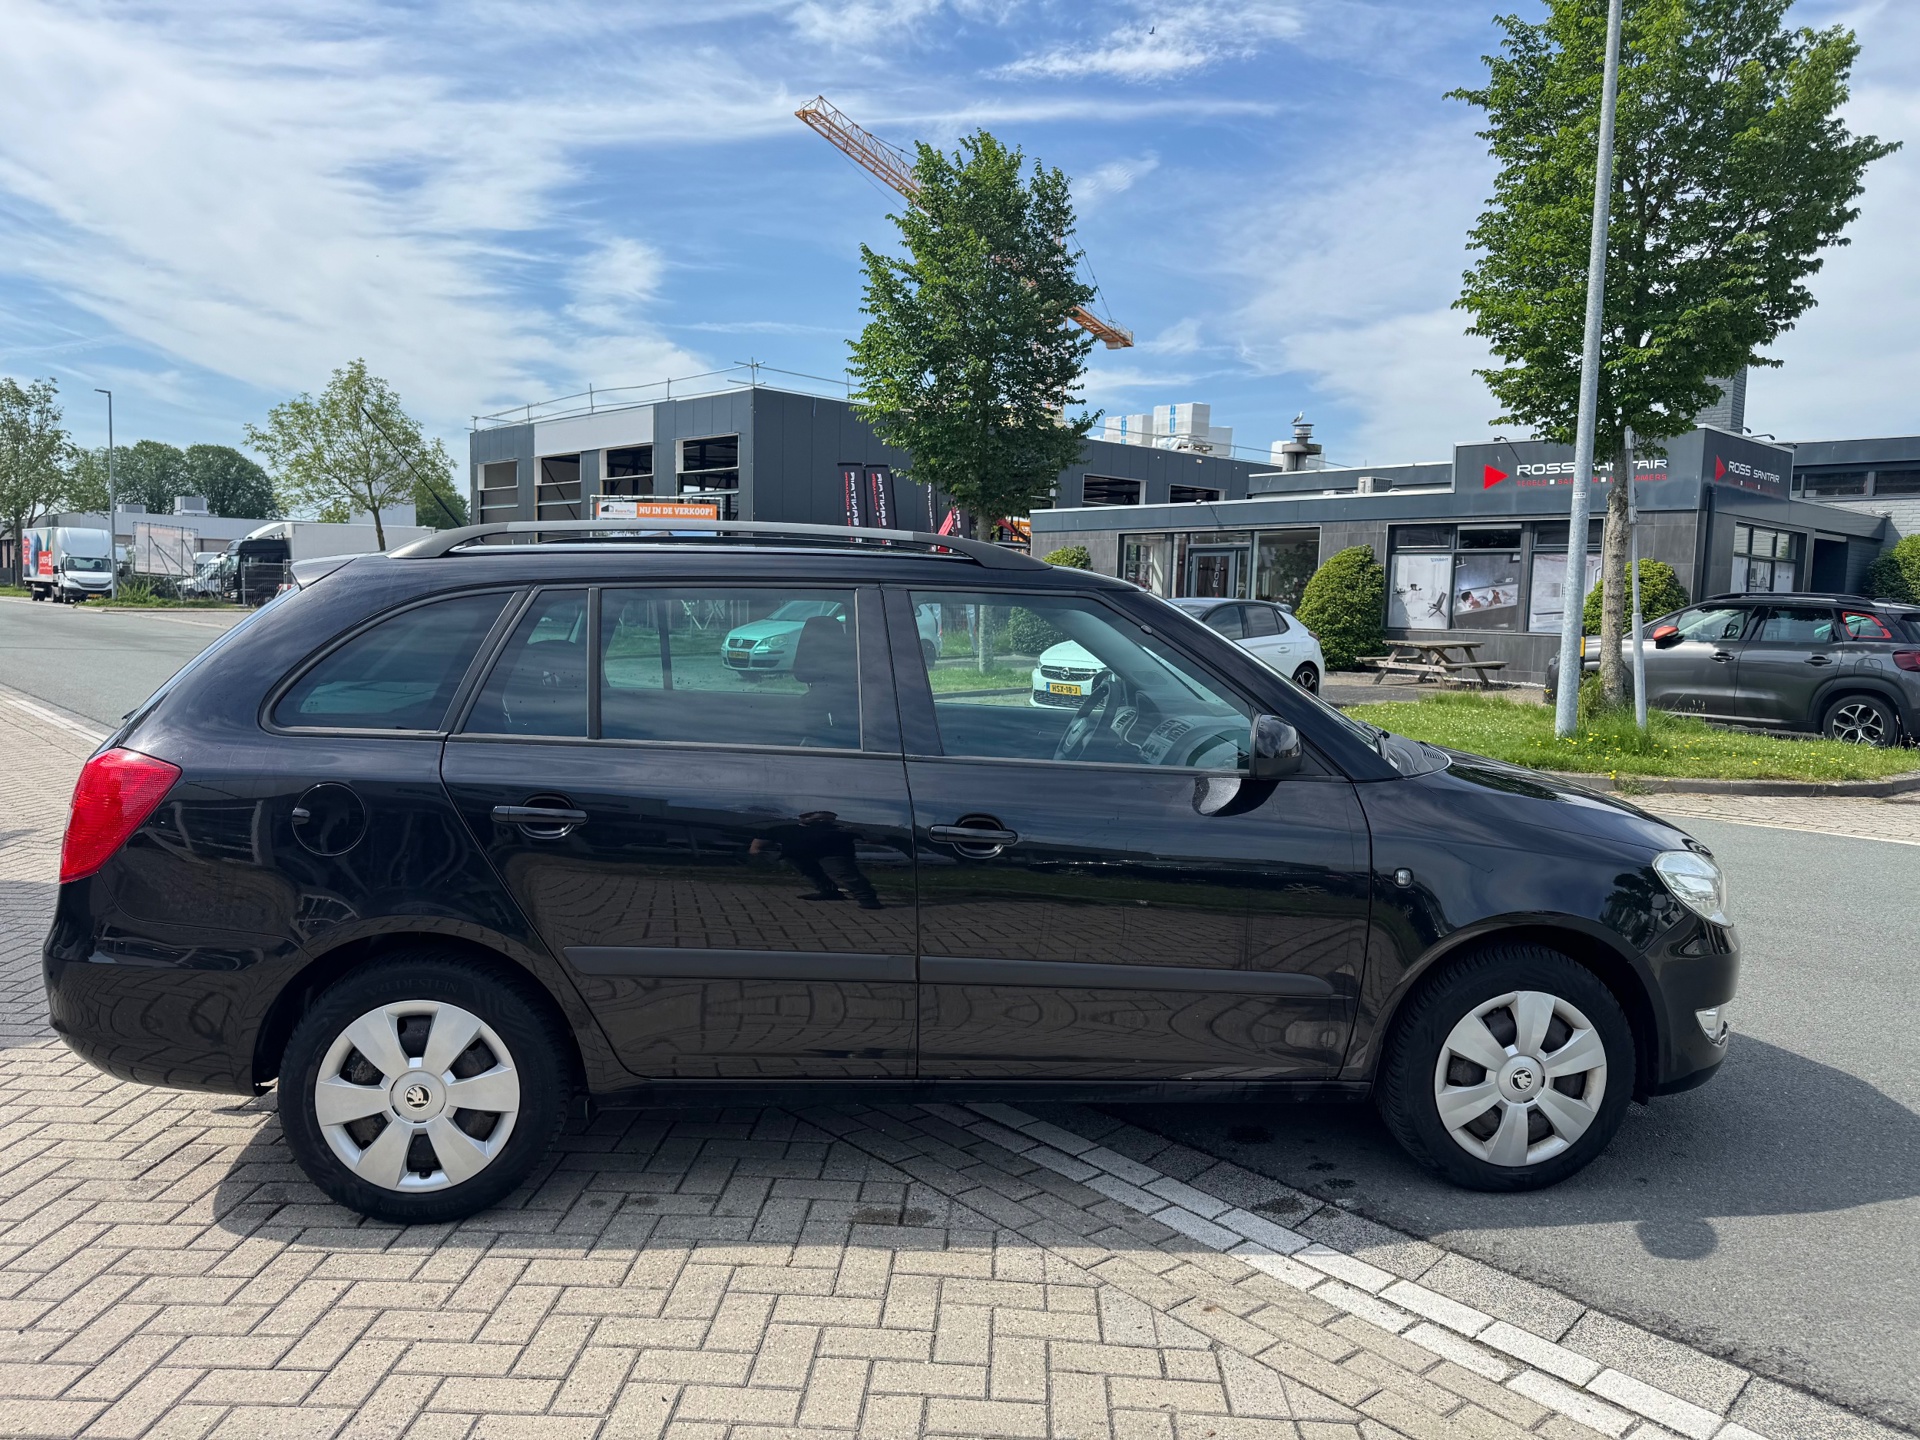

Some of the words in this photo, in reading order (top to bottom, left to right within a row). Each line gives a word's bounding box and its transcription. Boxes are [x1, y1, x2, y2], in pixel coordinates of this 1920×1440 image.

[1516, 462, 1575, 476] ROSS
[1728, 460, 1751, 477] ROSS
[1753, 469, 1780, 483] SANITAIR
[639, 506, 651, 515] NU
[652, 506, 661, 515] IN
[662, 507, 673, 515] DE
[674, 507, 713, 516] VERKOOP!
